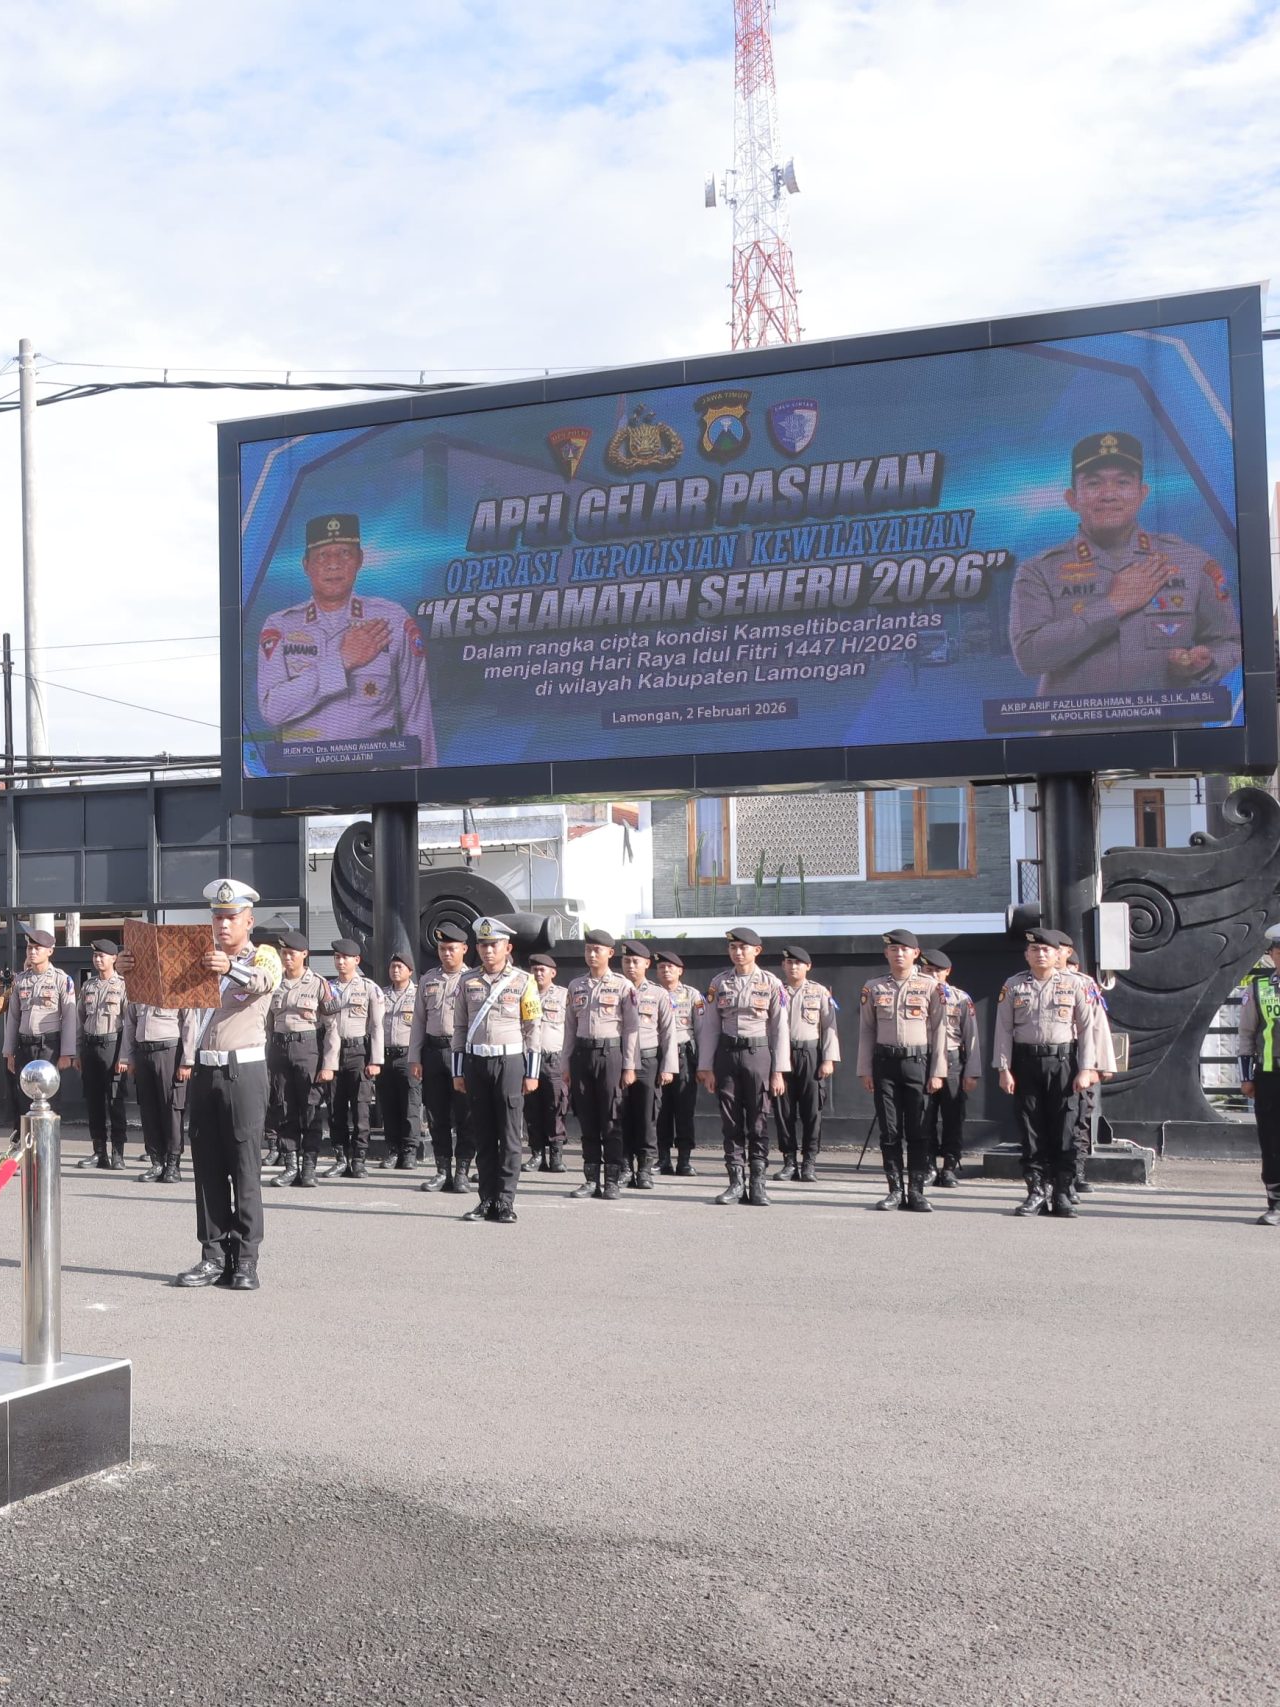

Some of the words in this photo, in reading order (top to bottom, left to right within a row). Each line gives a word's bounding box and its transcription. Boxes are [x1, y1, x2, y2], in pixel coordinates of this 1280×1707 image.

[468, 493, 565, 550] APEL
[574, 477, 711, 541] GELAR
[718, 452, 938, 523] PASUKAN
[446, 550, 561, 594] OPERASI
[571, 534, 738, 582] KEPOLISIAN
[751, 511, 972, 566] KEWILAYAHAN
[697, 562, 864, 619] SEMERU
[463, 643, 522, 661] Dalam
[528, 637, 594, 657] rangka
[600, 632, 650, 652] cipta
[655, 626, 727, 646] kondisi
[733, 611, 942, 641] Kamseltibcarlantas
[484, 658, 584, 680] menjelang
[590, 653, 632, 672] Hari
[637, 651, 686, 670] Raya
[692, 645, 730, 664] Idul
[736, 641, 777, 662] Fitri
[784, 638, 836, 658] 1447
[841, 632, 918, 654] H/2026
[535, 680, 552, 696] di
[558, 675, 632, 696] wilayah
[637, 666, 748, 690] Kabupaten
[754, 661, 866, 682] Lamongan
[612, 710, 683, 724] Lamongan,
[686, 707, 695, 720] 2
[697, 704, 750, 719] Februari
[755, 701, 787, 716] 2026
[1001, 702, 1027, 712] AKBP
[1029, 701, 1051, 711] ARIF
[1053, 696, 1135, 710] FAZLURRAHMAN,
[1051, 710, 1103, 722] KAPOLRES
[1106, 707, 1161, 719] LAMONGAN
[315, 755, 350, 764] KAPOLDA
[352, 753, 374, 761] JATIM
